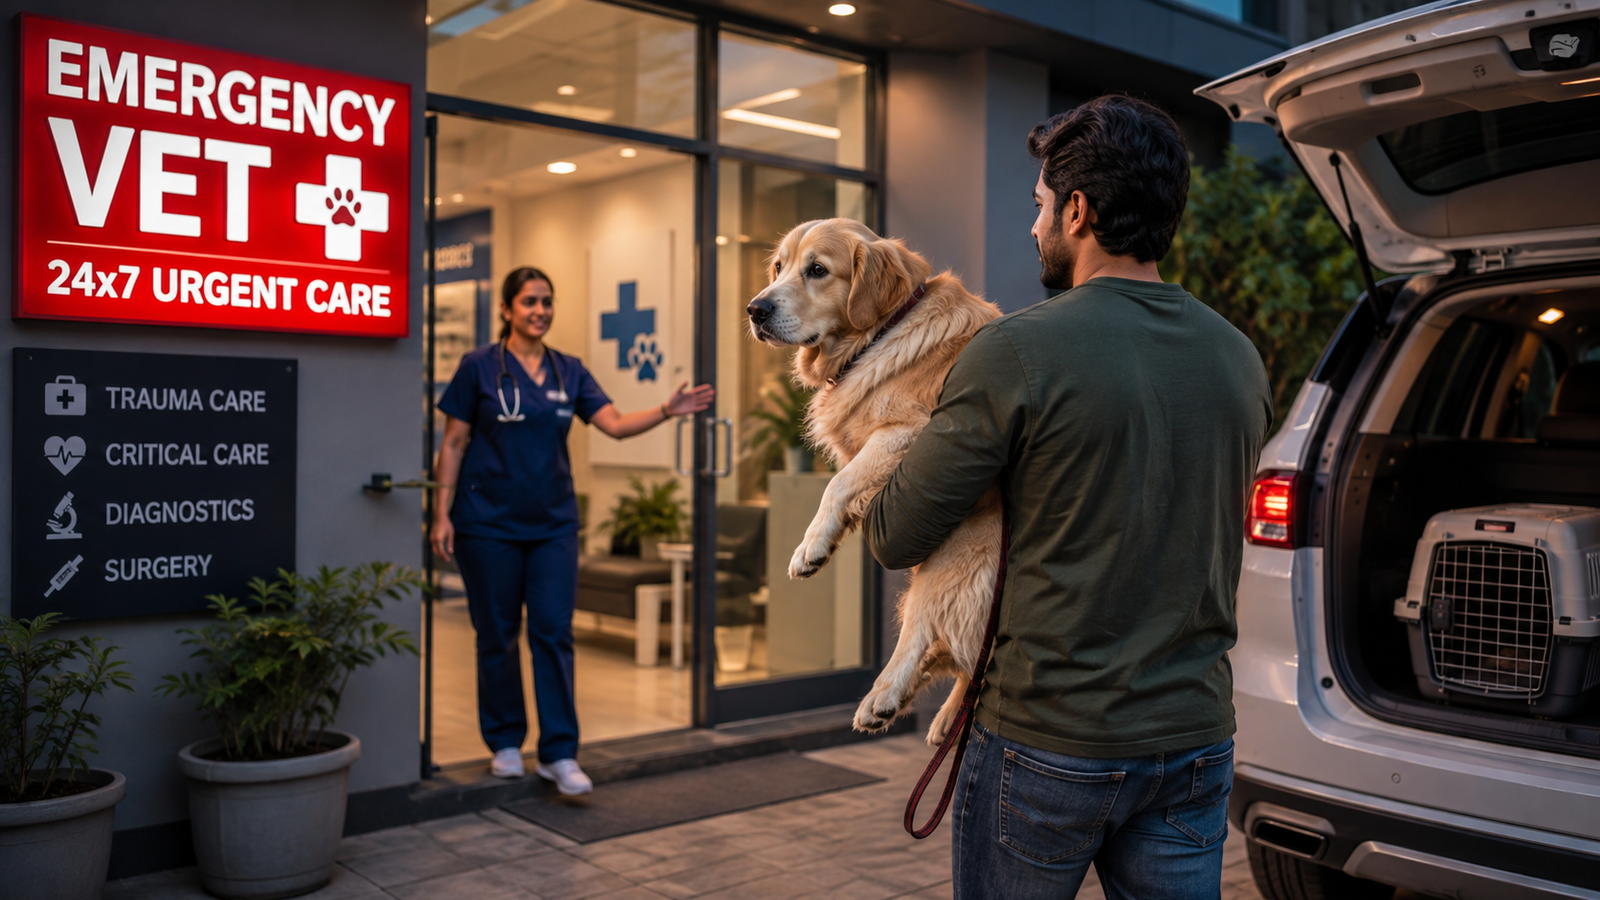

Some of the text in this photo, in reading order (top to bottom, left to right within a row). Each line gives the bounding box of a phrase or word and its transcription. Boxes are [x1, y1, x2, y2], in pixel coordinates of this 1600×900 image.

[47, 38, 396, 147] EMERGENCY
[47, 116, 272, 243] VET
[47, 259, 392, 318] 24x7 URGENT CARE
[105, 386, 267, 413] TRAUMA CARE
[105, 443, 269, 466] CRITICAL CARE
[106, 498, 255, 526] DIAGNOSTICS
[104, 554, 213, 583] SURGERY
